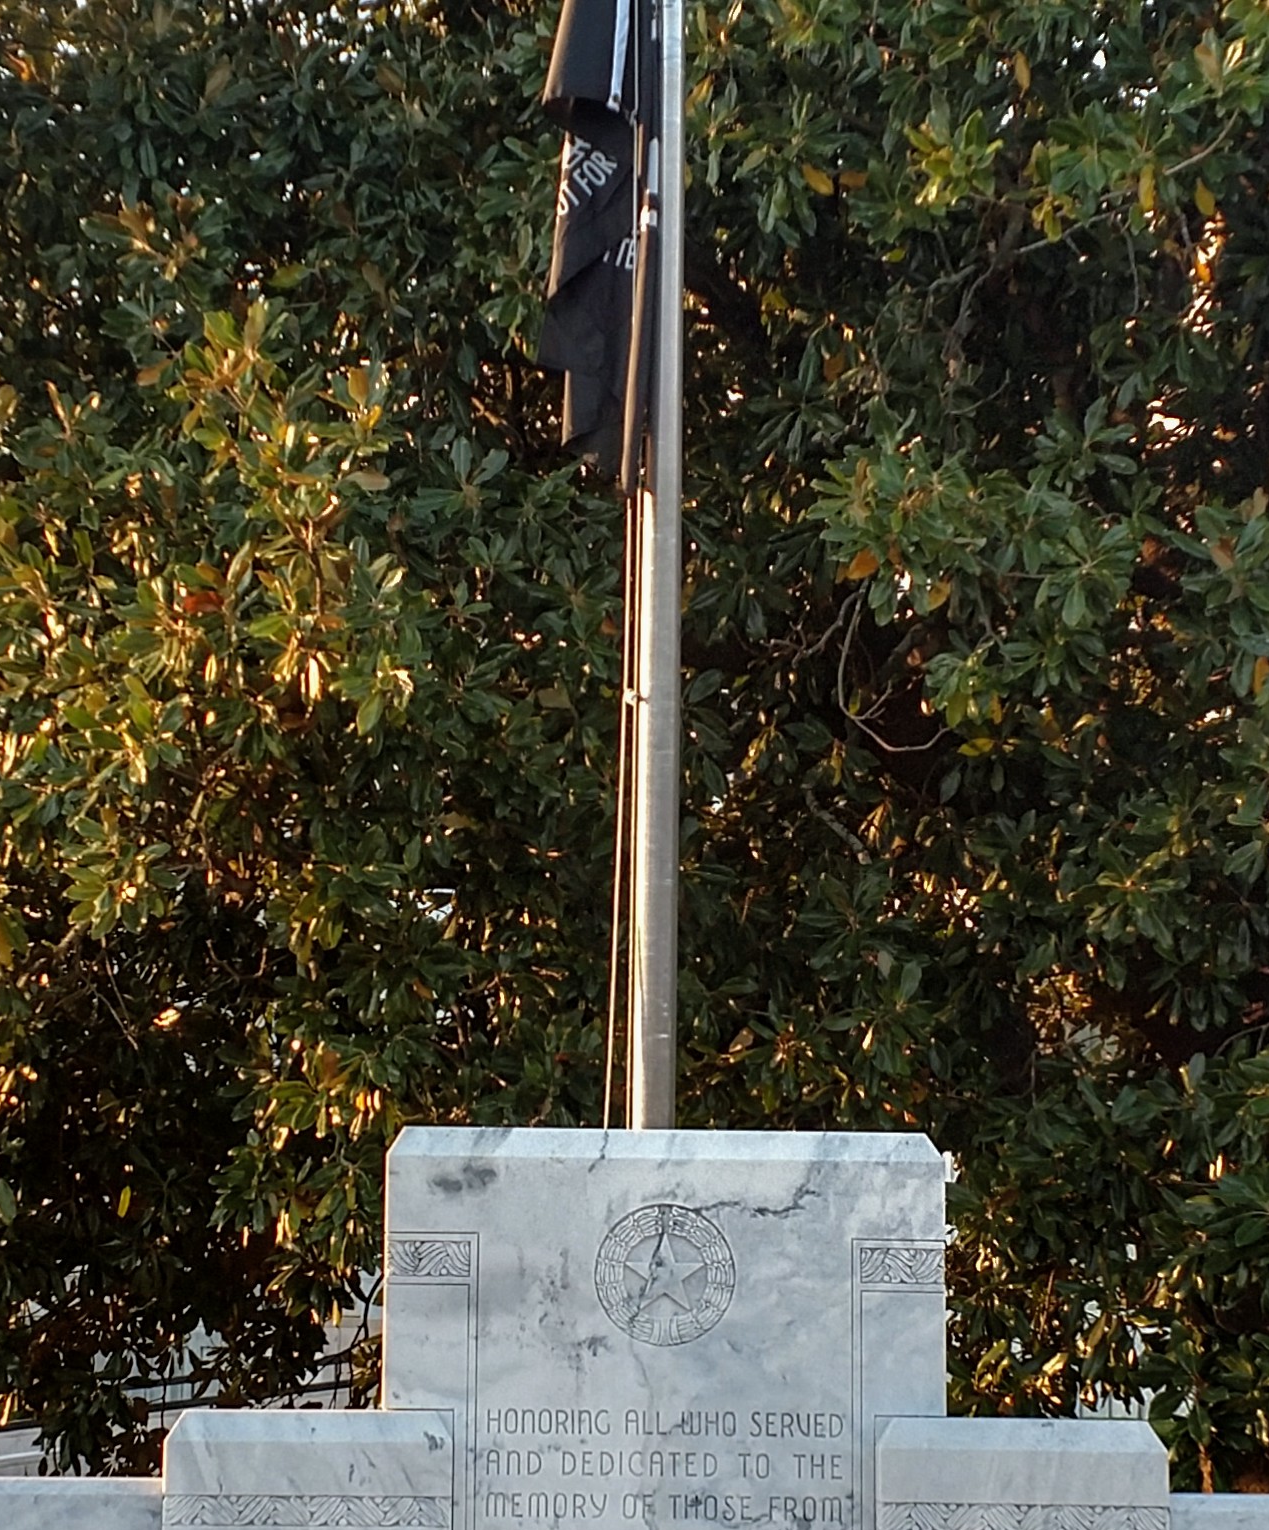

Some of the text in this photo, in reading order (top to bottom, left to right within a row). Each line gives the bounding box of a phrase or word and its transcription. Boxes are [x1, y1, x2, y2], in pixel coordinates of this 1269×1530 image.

[486, 1407, 844, 1439] HONORING ALL WHO SERVED
[485, 1449, 843, 1481] AND DEDICATED TO THE
[485, 1491, 844, 1524] MEMORY OF THOSE FROM
